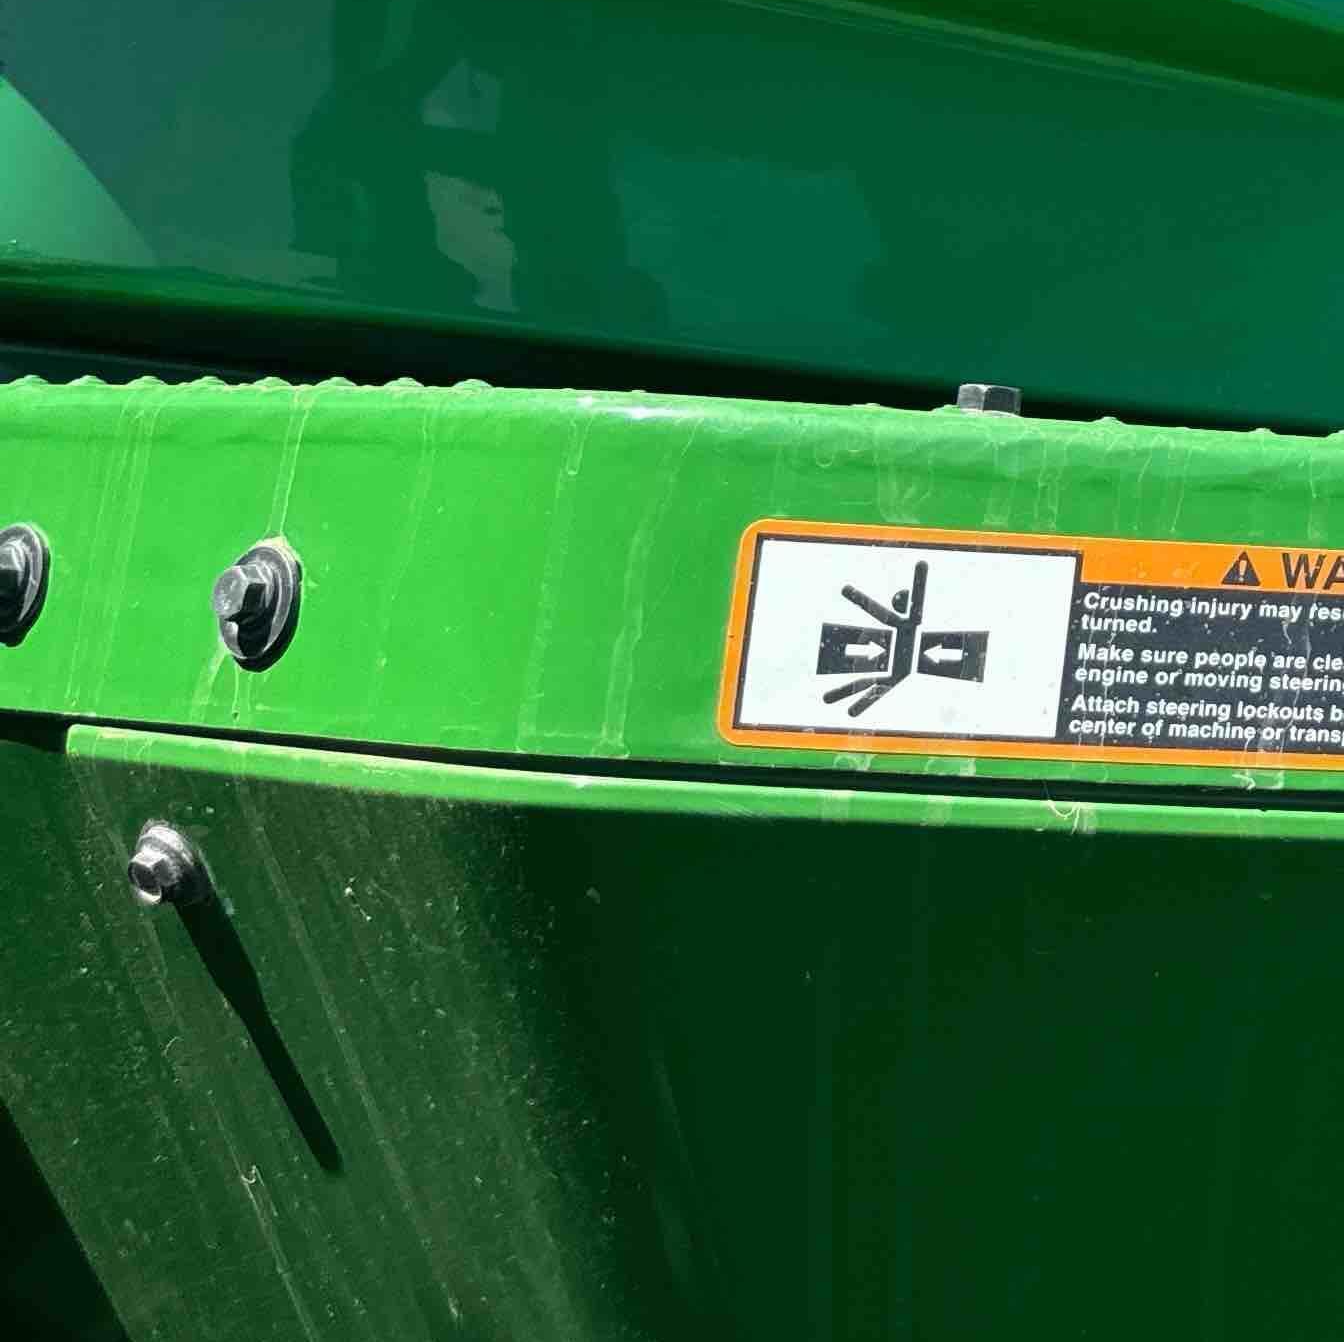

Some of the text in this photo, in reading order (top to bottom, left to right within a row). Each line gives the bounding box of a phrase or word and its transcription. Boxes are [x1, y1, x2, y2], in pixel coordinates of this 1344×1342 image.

[1083, 592, 1184, 616] Crushing
[1190, 597, 1251, 620] injury
[1259, 604, 1302, 622] may
[1081, 614, 1157, 633] turned.
[1078, 643, 1133, 662] Make
[1141, 648, 1188, 664] sure
[1194, 649, 1266, 669] people
[1273, 654, 1306, 669] are
[1075, 667, 1148, 686] engine
[1155, 670, 1178, 685] or
[1184, 672, 1262, 693] moving
[1071, 694, 1139, 714] Attach
[1146, 699, 1230, 721] steering
[1237, 701, 1324, 722] lockouts
[1069, 718, 1139, 735] center
[1142, 720, 1164, 737] of
[1168, 722, 1256, 740] machine
[1262, 726, 1283, 740] or
